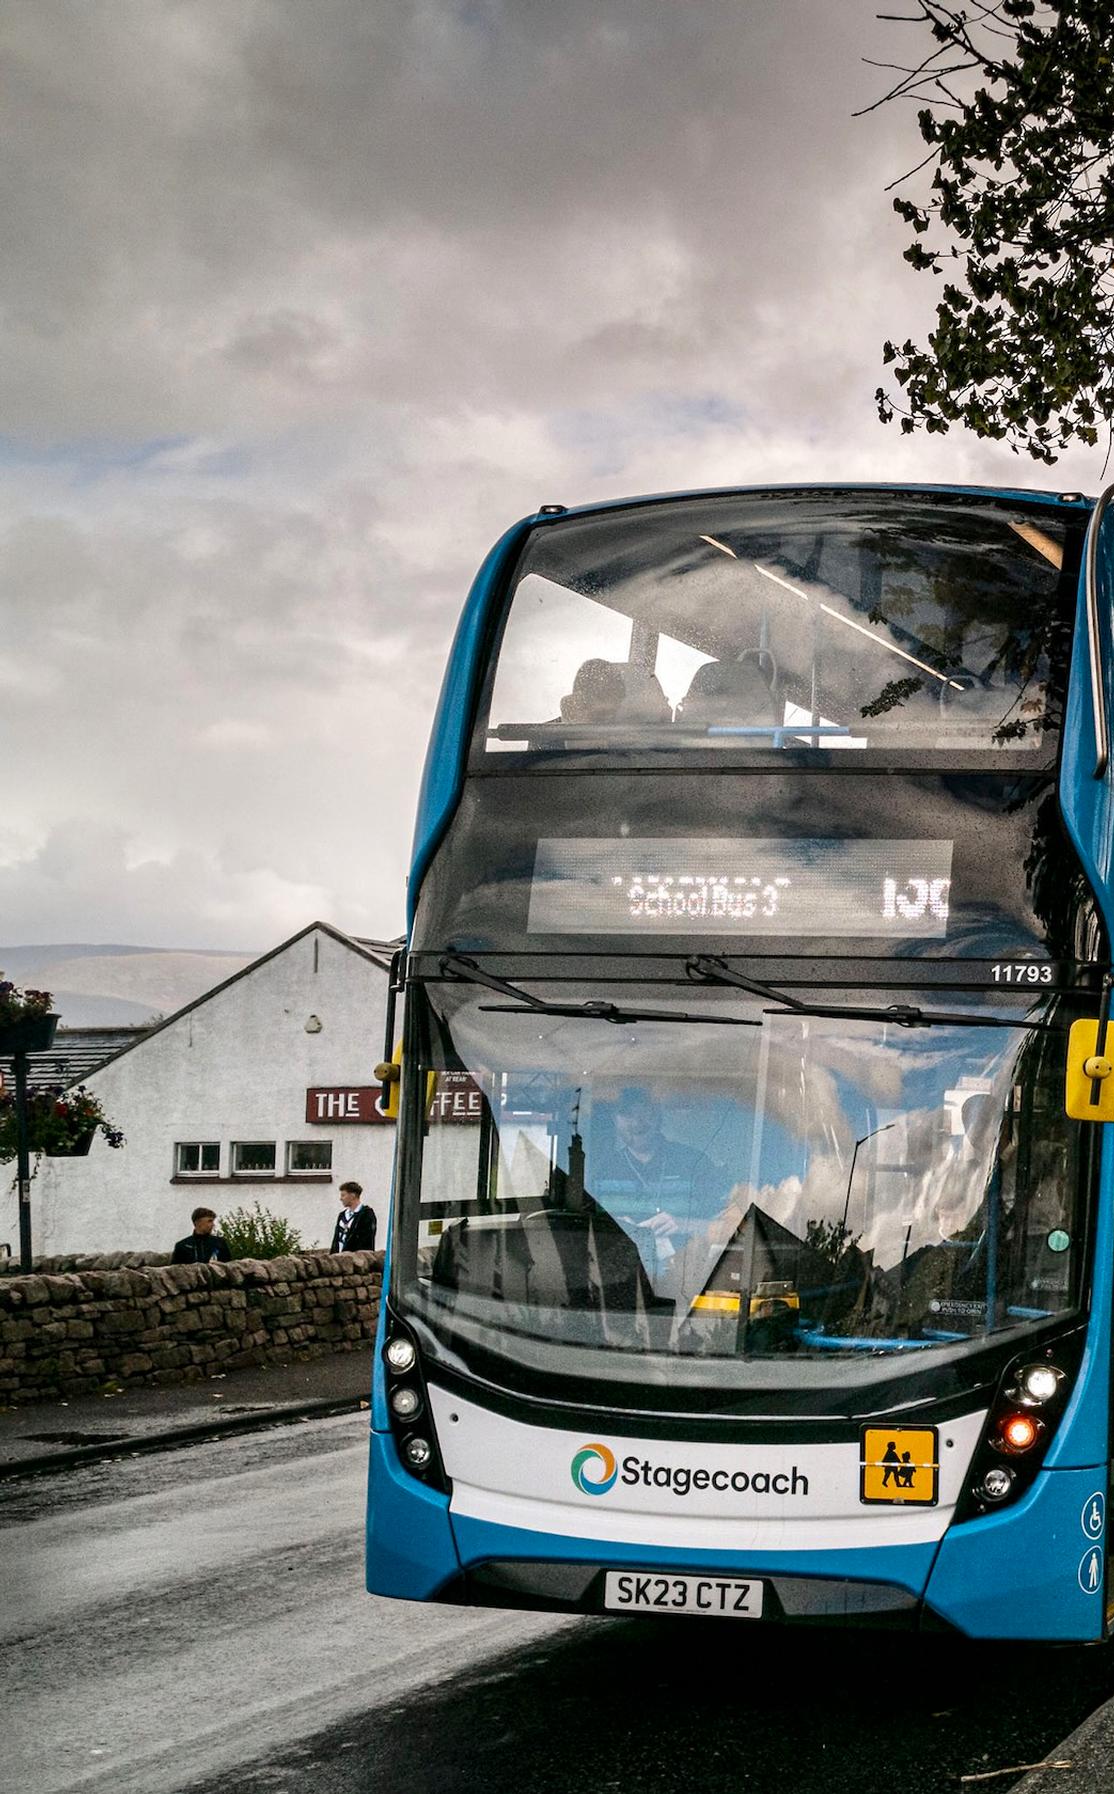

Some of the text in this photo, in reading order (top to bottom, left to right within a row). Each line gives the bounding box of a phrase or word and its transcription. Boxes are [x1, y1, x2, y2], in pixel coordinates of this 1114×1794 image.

[991, 965, 1052, 983] 11793
[315, 1093, 360, 1117] THE
[621, 1456, 809, 1496] Stagecoach
[617, 1576, 751, 1611] SK23 CTZ
